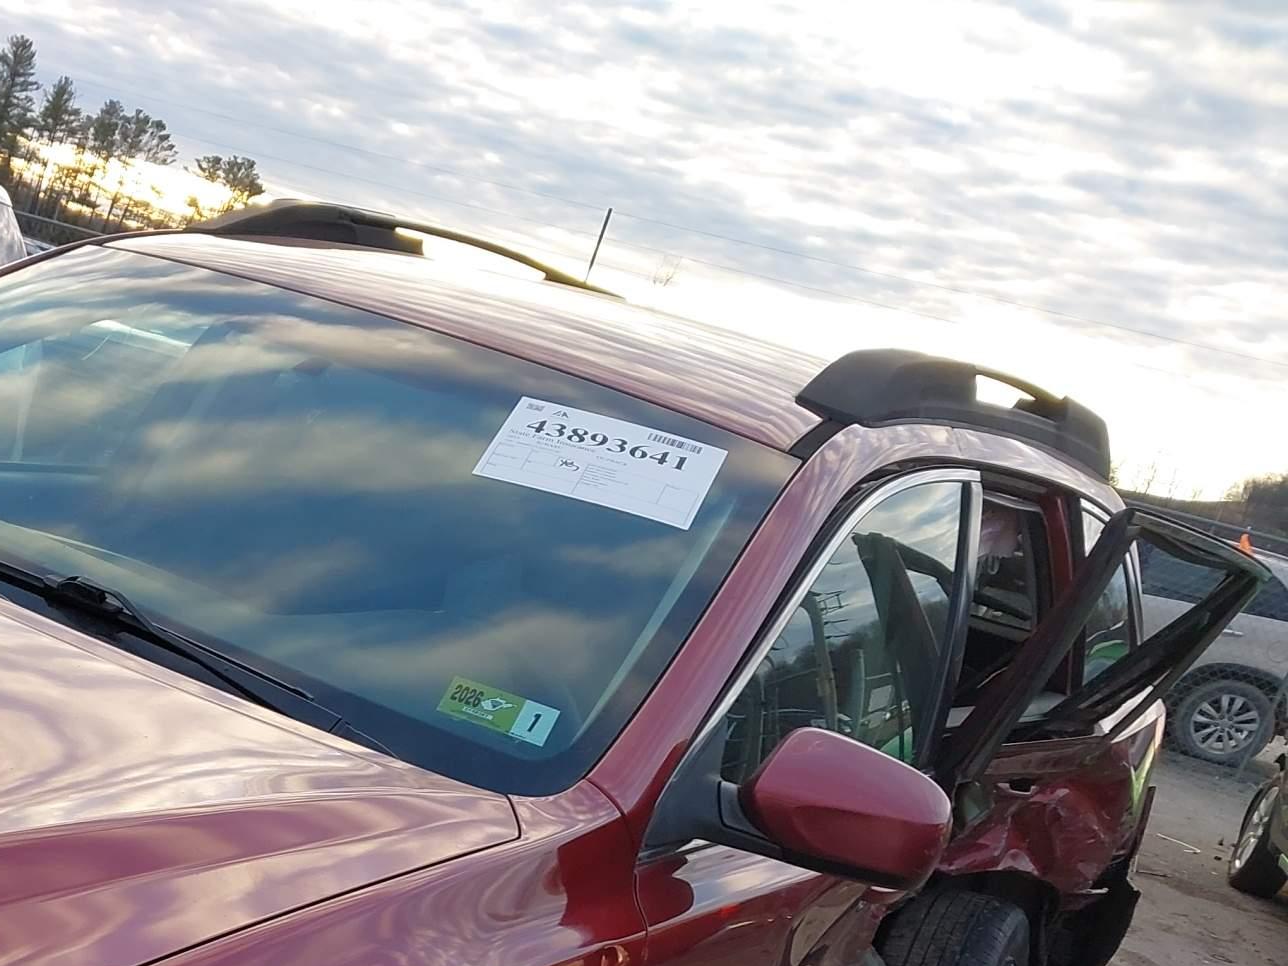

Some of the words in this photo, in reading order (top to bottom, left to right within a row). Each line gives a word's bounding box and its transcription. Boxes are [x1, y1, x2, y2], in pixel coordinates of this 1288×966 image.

[526, 419, 688, 472] 43893641
[450, 684, 485, 708] 2026
[527, 713, 543, 733] 1
